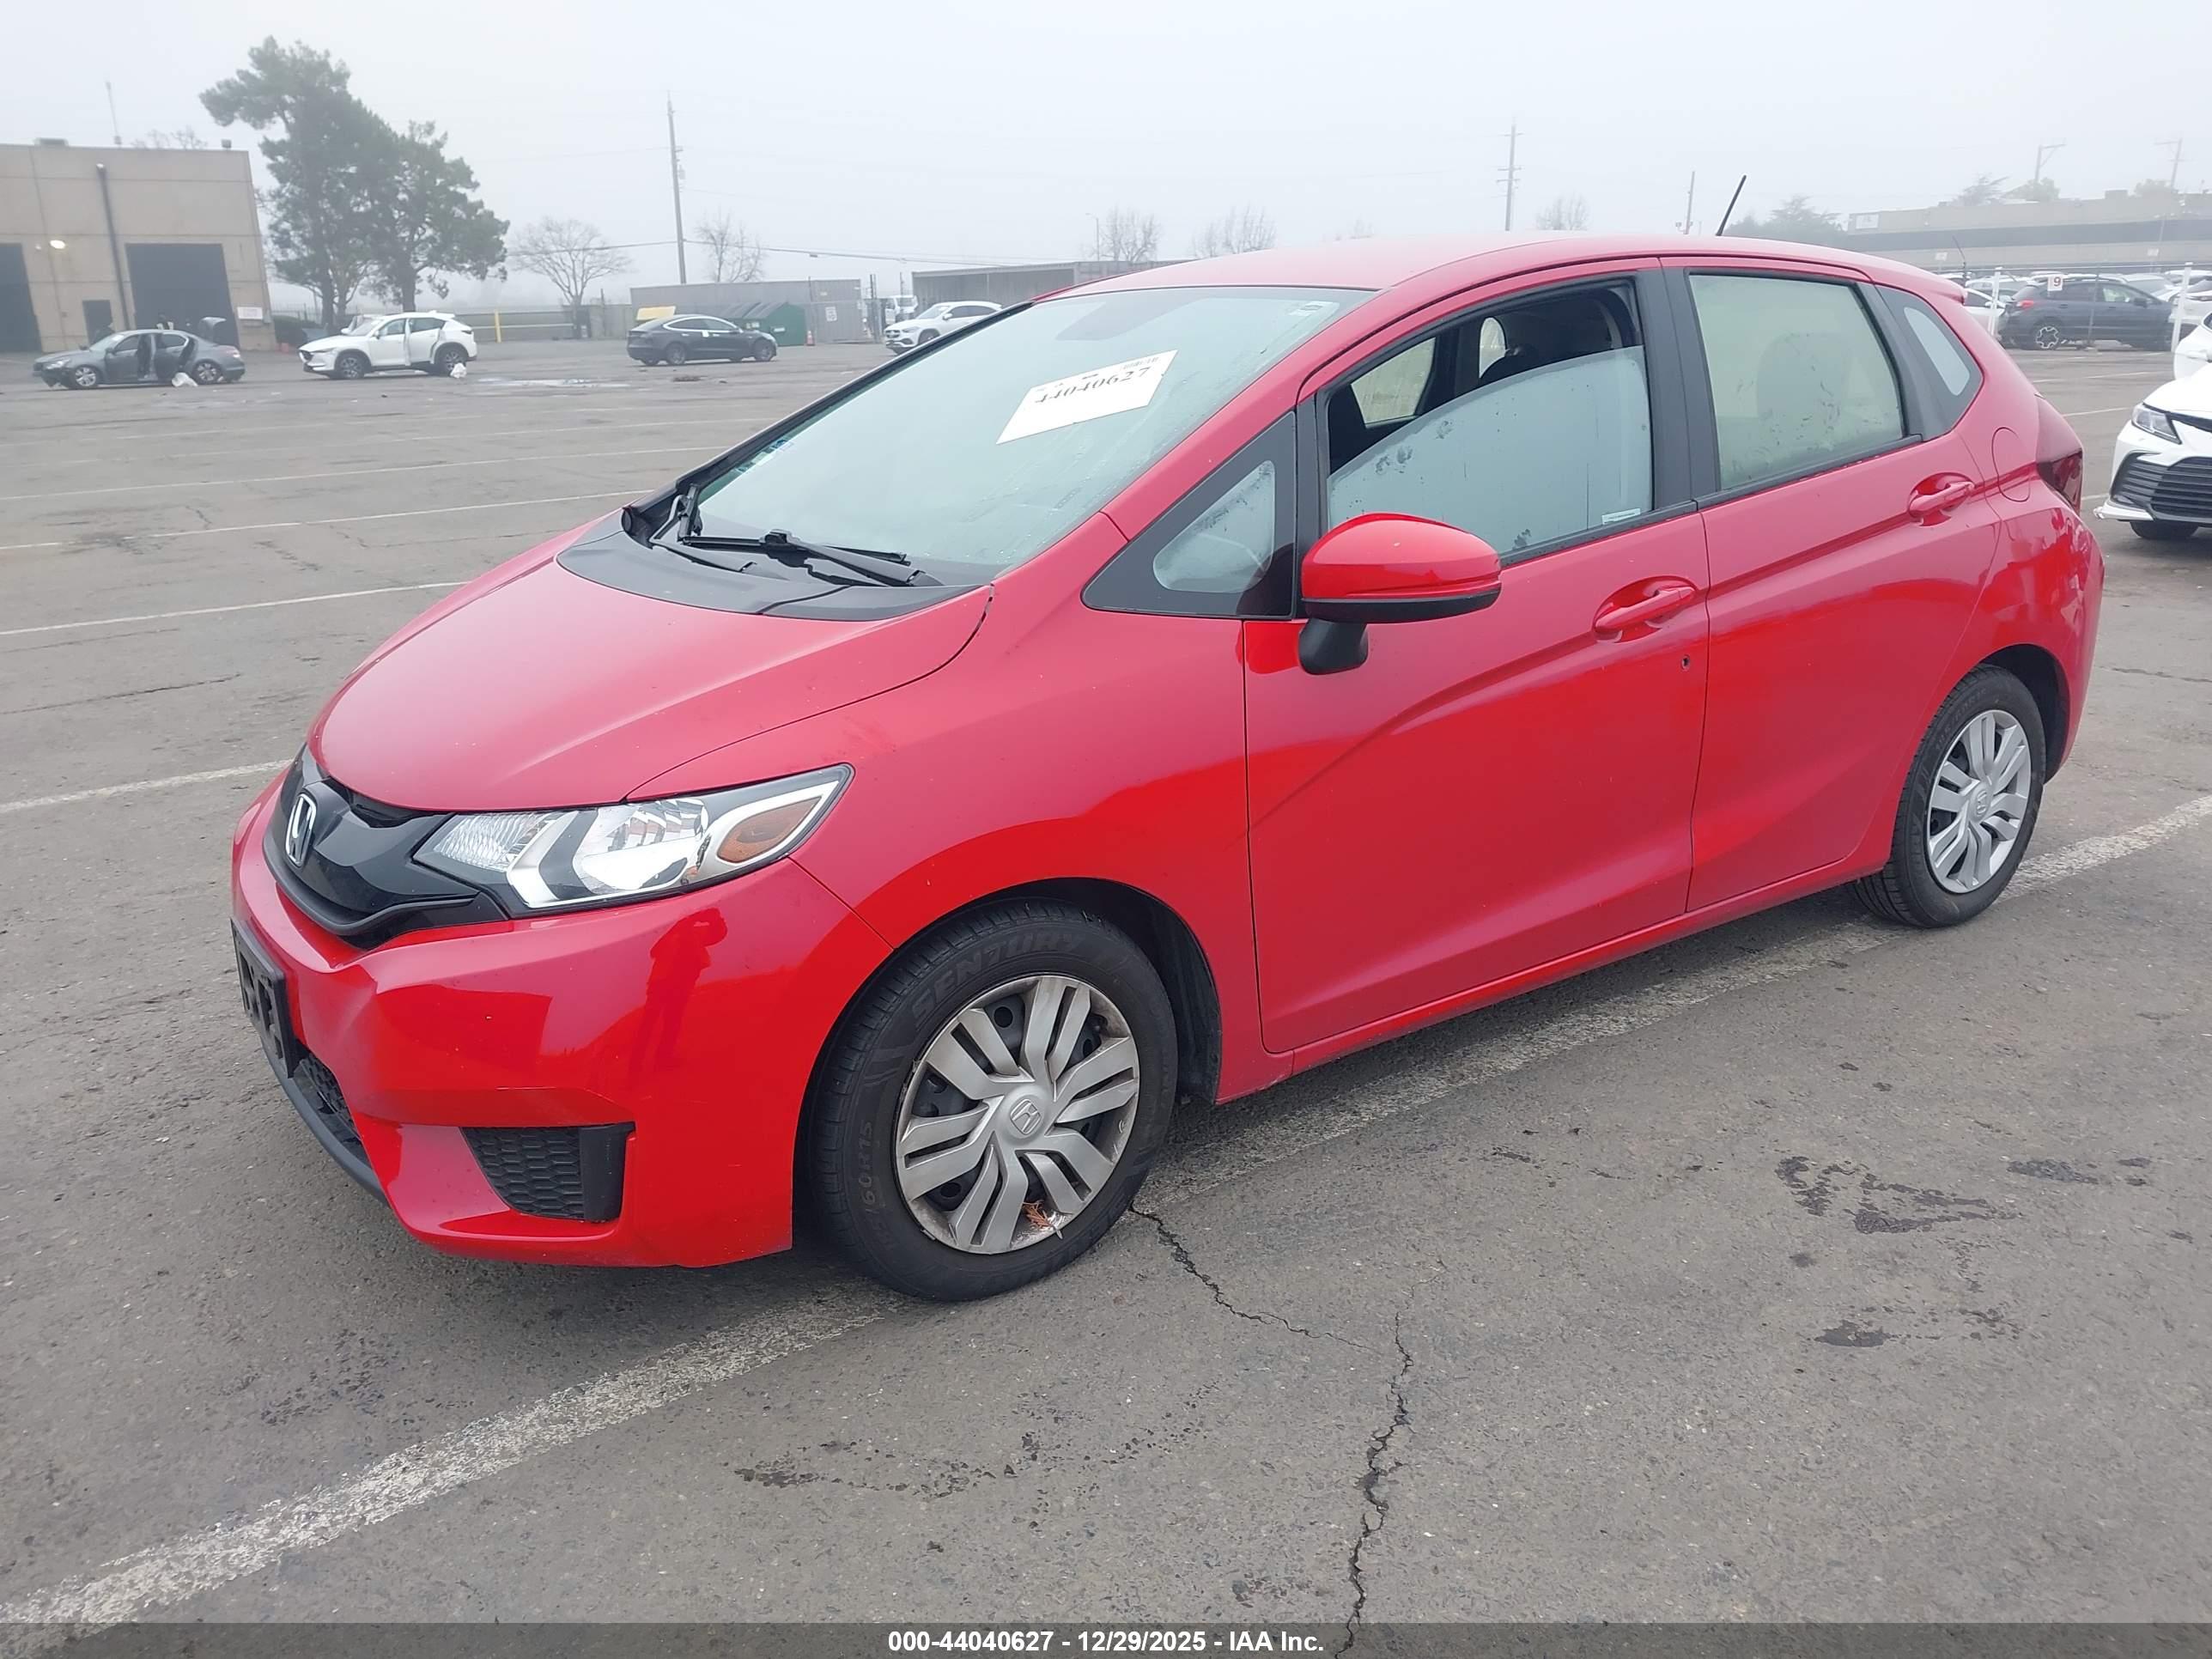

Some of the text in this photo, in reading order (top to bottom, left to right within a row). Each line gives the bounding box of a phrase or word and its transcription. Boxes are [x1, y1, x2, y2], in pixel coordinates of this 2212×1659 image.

[2053, 276, 2062, 287] 9
[1035, 367, 1151, 403] 44040627
[911, 932, 1084, 1017] SENTURY
